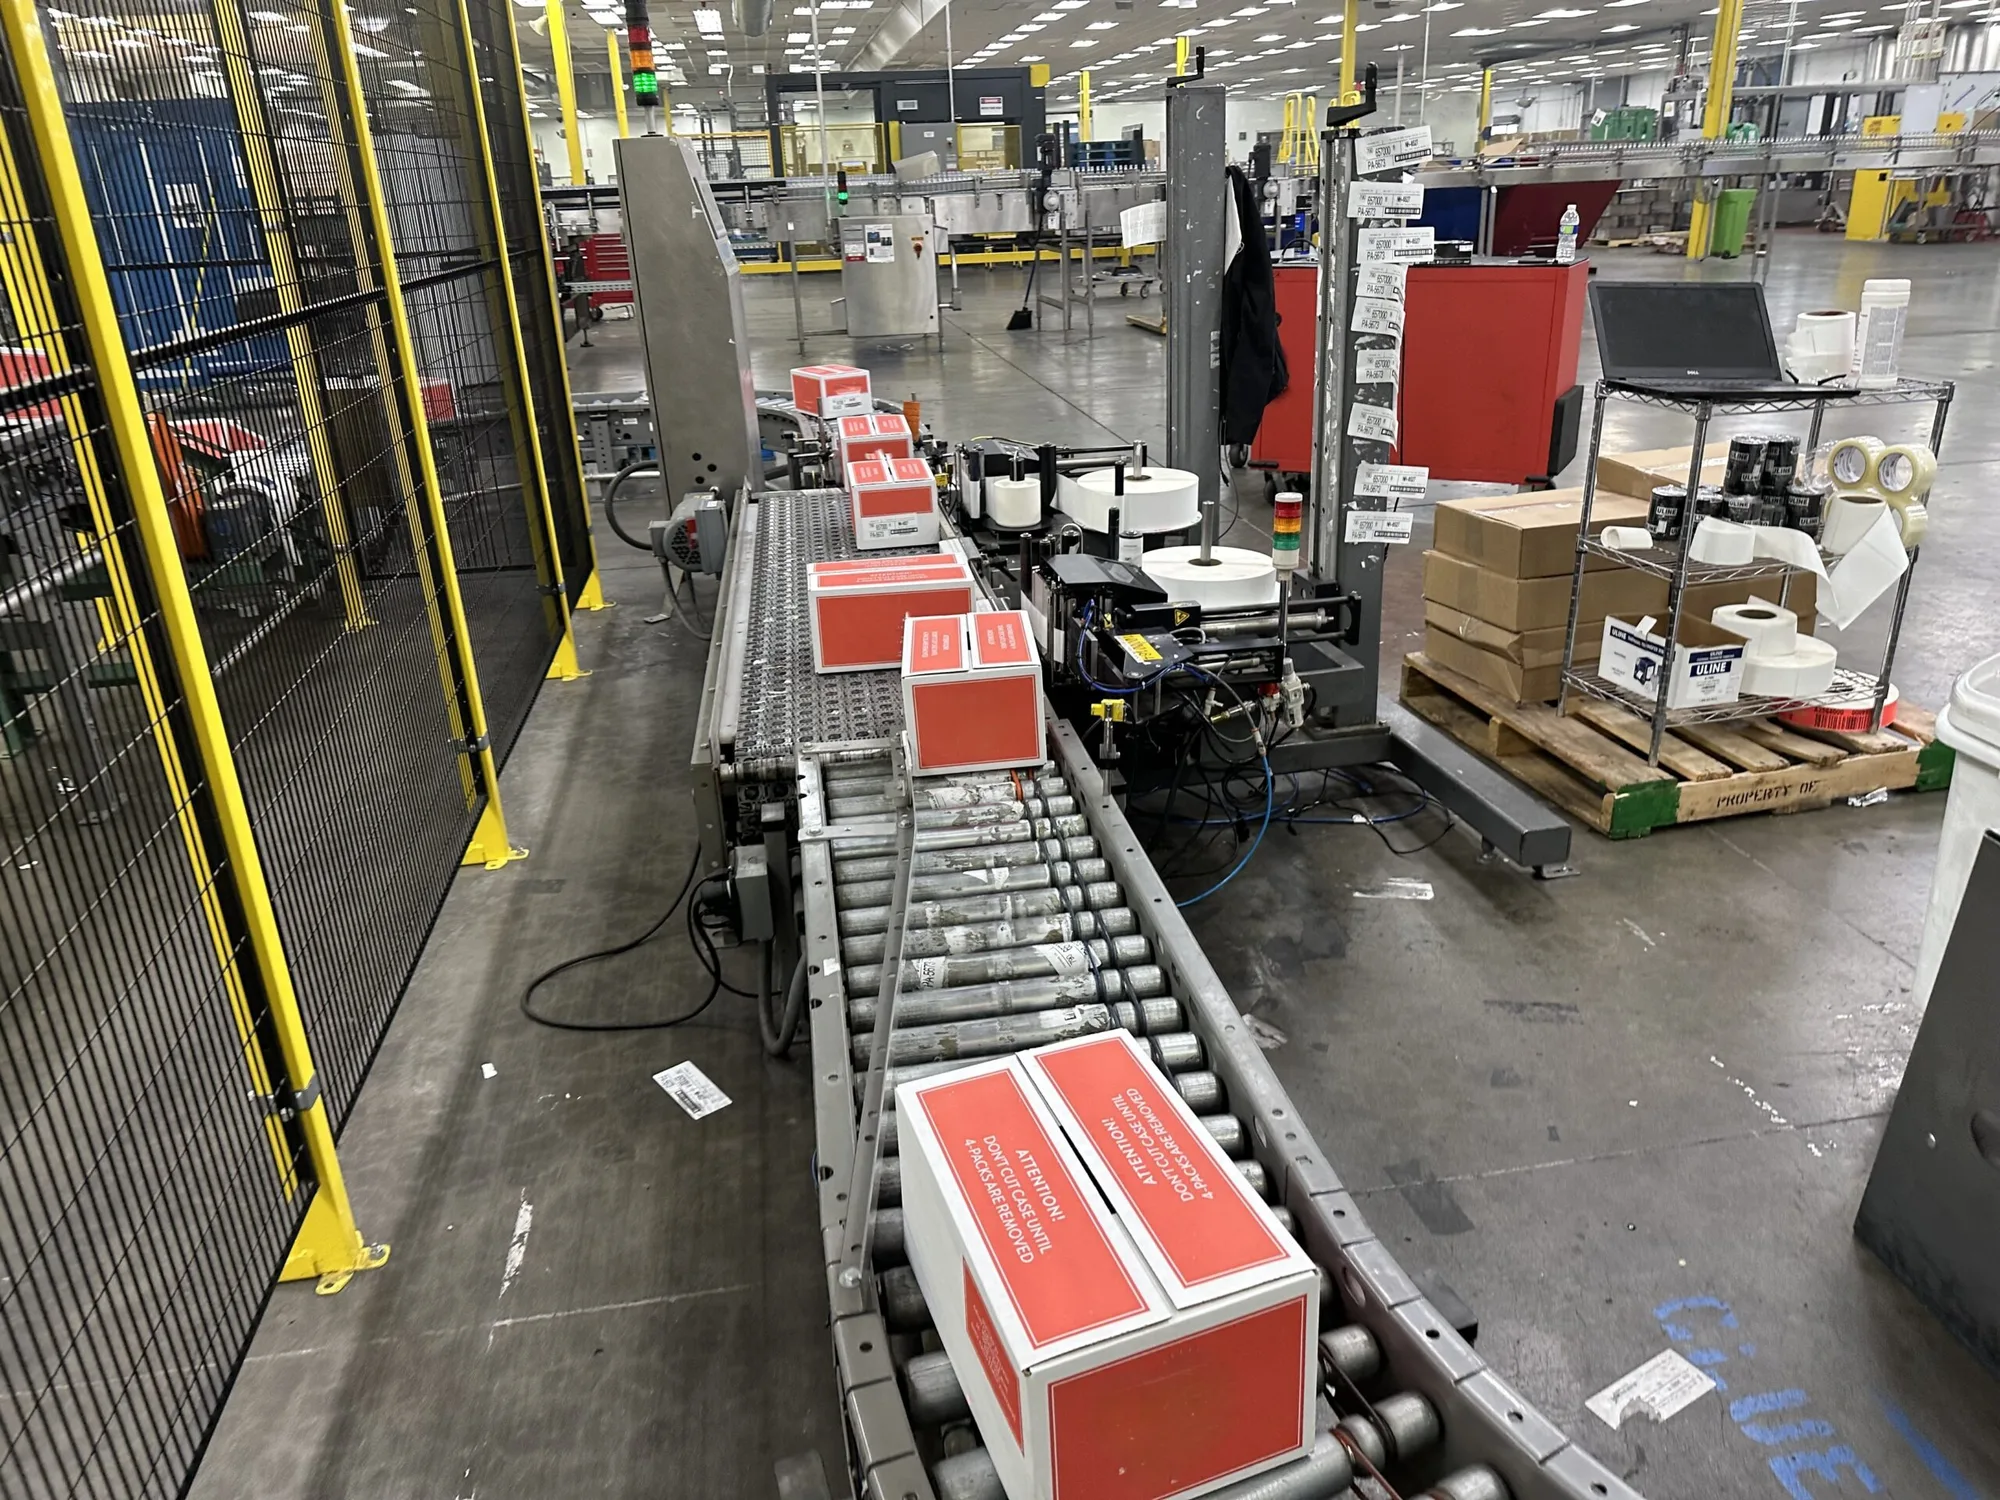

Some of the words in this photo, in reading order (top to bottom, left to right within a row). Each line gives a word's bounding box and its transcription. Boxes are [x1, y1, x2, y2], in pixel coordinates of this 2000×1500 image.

[1368, 158, 1386, 170] PA-5673
[1358, 207, 1376, 216] PA-5673
[1366, 251, 1385, 260] PA-5673
[1366, 285, 1384, 294] PA-5673
[1361, 320, 1379, 330] PA-5673
[1730, 500, 1749, 508] ULINE
[1789, 498, 1808, 506] ULINE
[1612, 628, 1626, 640] ULINE
[1696, 662, 1727, 676] ULINE
[1716, 784, 1792, 808] PROPERTY
[1800, 780, 1819, 794] OF
[1112, 1093, 1136, 1122] UNTIL
[1126, 1088, 1168, 1135] REMOVED
[1129, 1122, 1154, 1147] CASE
[1101, 1117, 1158, 1185] ATTENTION!
[1160, 1135, 1182, 1156] ARE
[1147, 1147, 1169, 1168] CUT
[1015, 1150, 1066, 1222] ATTENTION!
[1175, 1155, 1214, 1199] 4-PACKS
[965, 1139, 994, 1182] 4-PACKS
[984, 1182, 1006, 1205] ARE
[996, 1204, 1034, 1264] REMOVED
[1000, 1168, 1021, 1189] CUT
[1011, 1189, 1036, 1219] CASE
[1027, 1218, 1052, 1255] UNTIL
